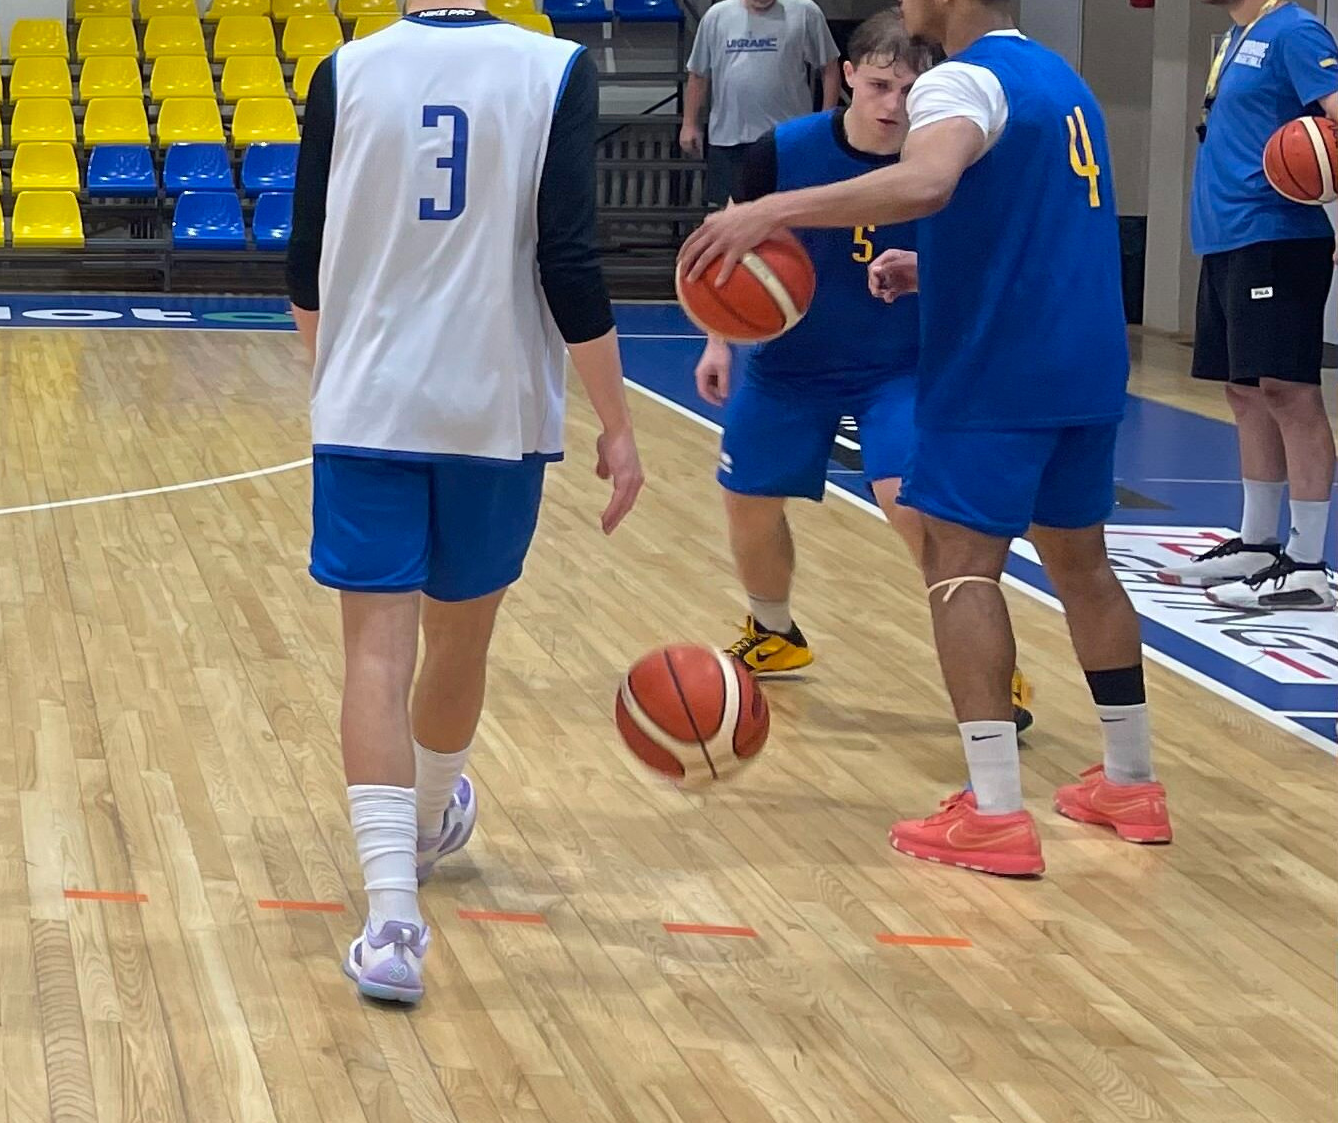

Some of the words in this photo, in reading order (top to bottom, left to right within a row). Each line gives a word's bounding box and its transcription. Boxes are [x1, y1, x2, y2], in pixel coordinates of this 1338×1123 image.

[418, 9, 448, 18] NIKE
[448, 8, 476, 17] PRO
[418, 104, 470, 221] 3
[1066, 105, 1101, 208] 4
[851, 224, 876, 263] 5
